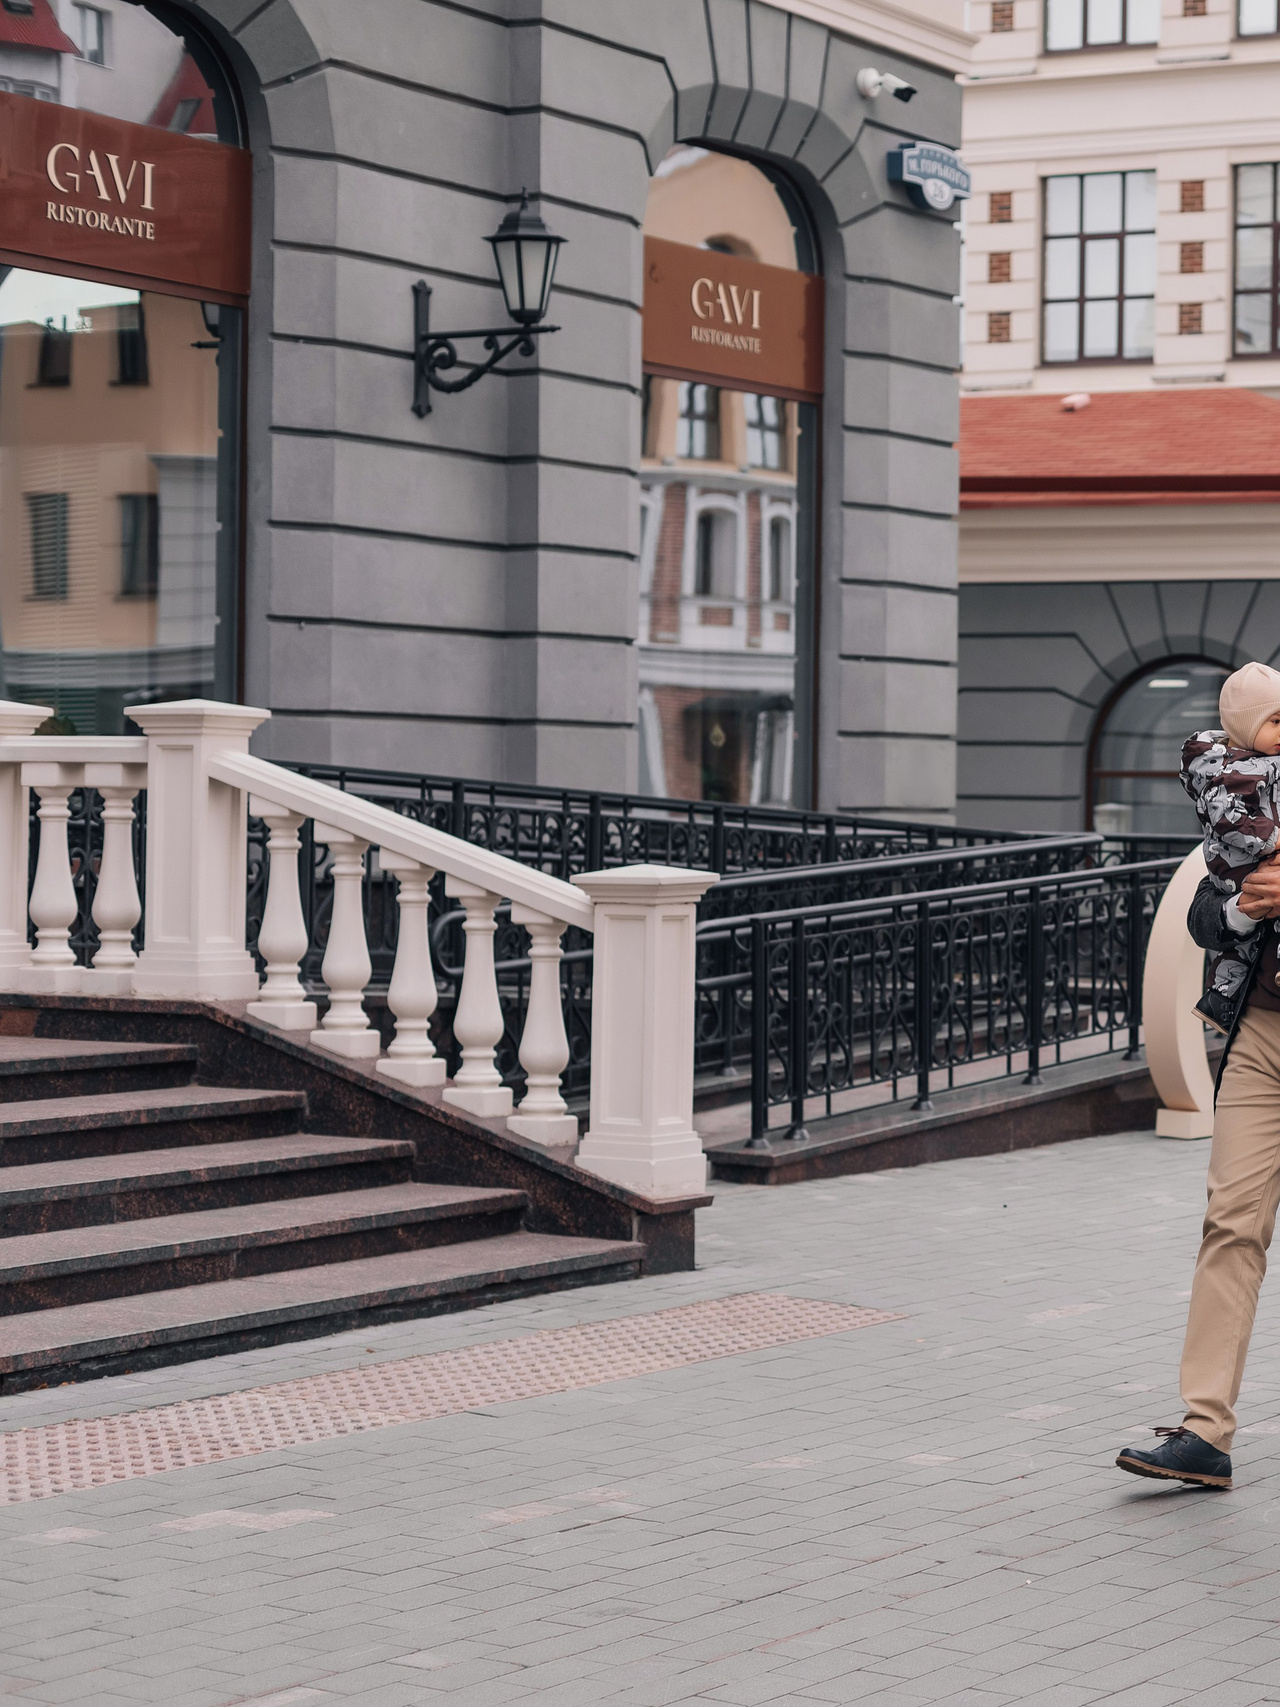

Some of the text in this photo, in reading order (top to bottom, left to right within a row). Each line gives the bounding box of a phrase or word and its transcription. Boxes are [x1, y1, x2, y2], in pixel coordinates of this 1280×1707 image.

[46, 142, 156, 210] GAVI
[46, 201, 156, 241] RISTORANTE
[691, 277, 761, 330] GAVI
[691, 325, 761, 354] RISTORANTE
